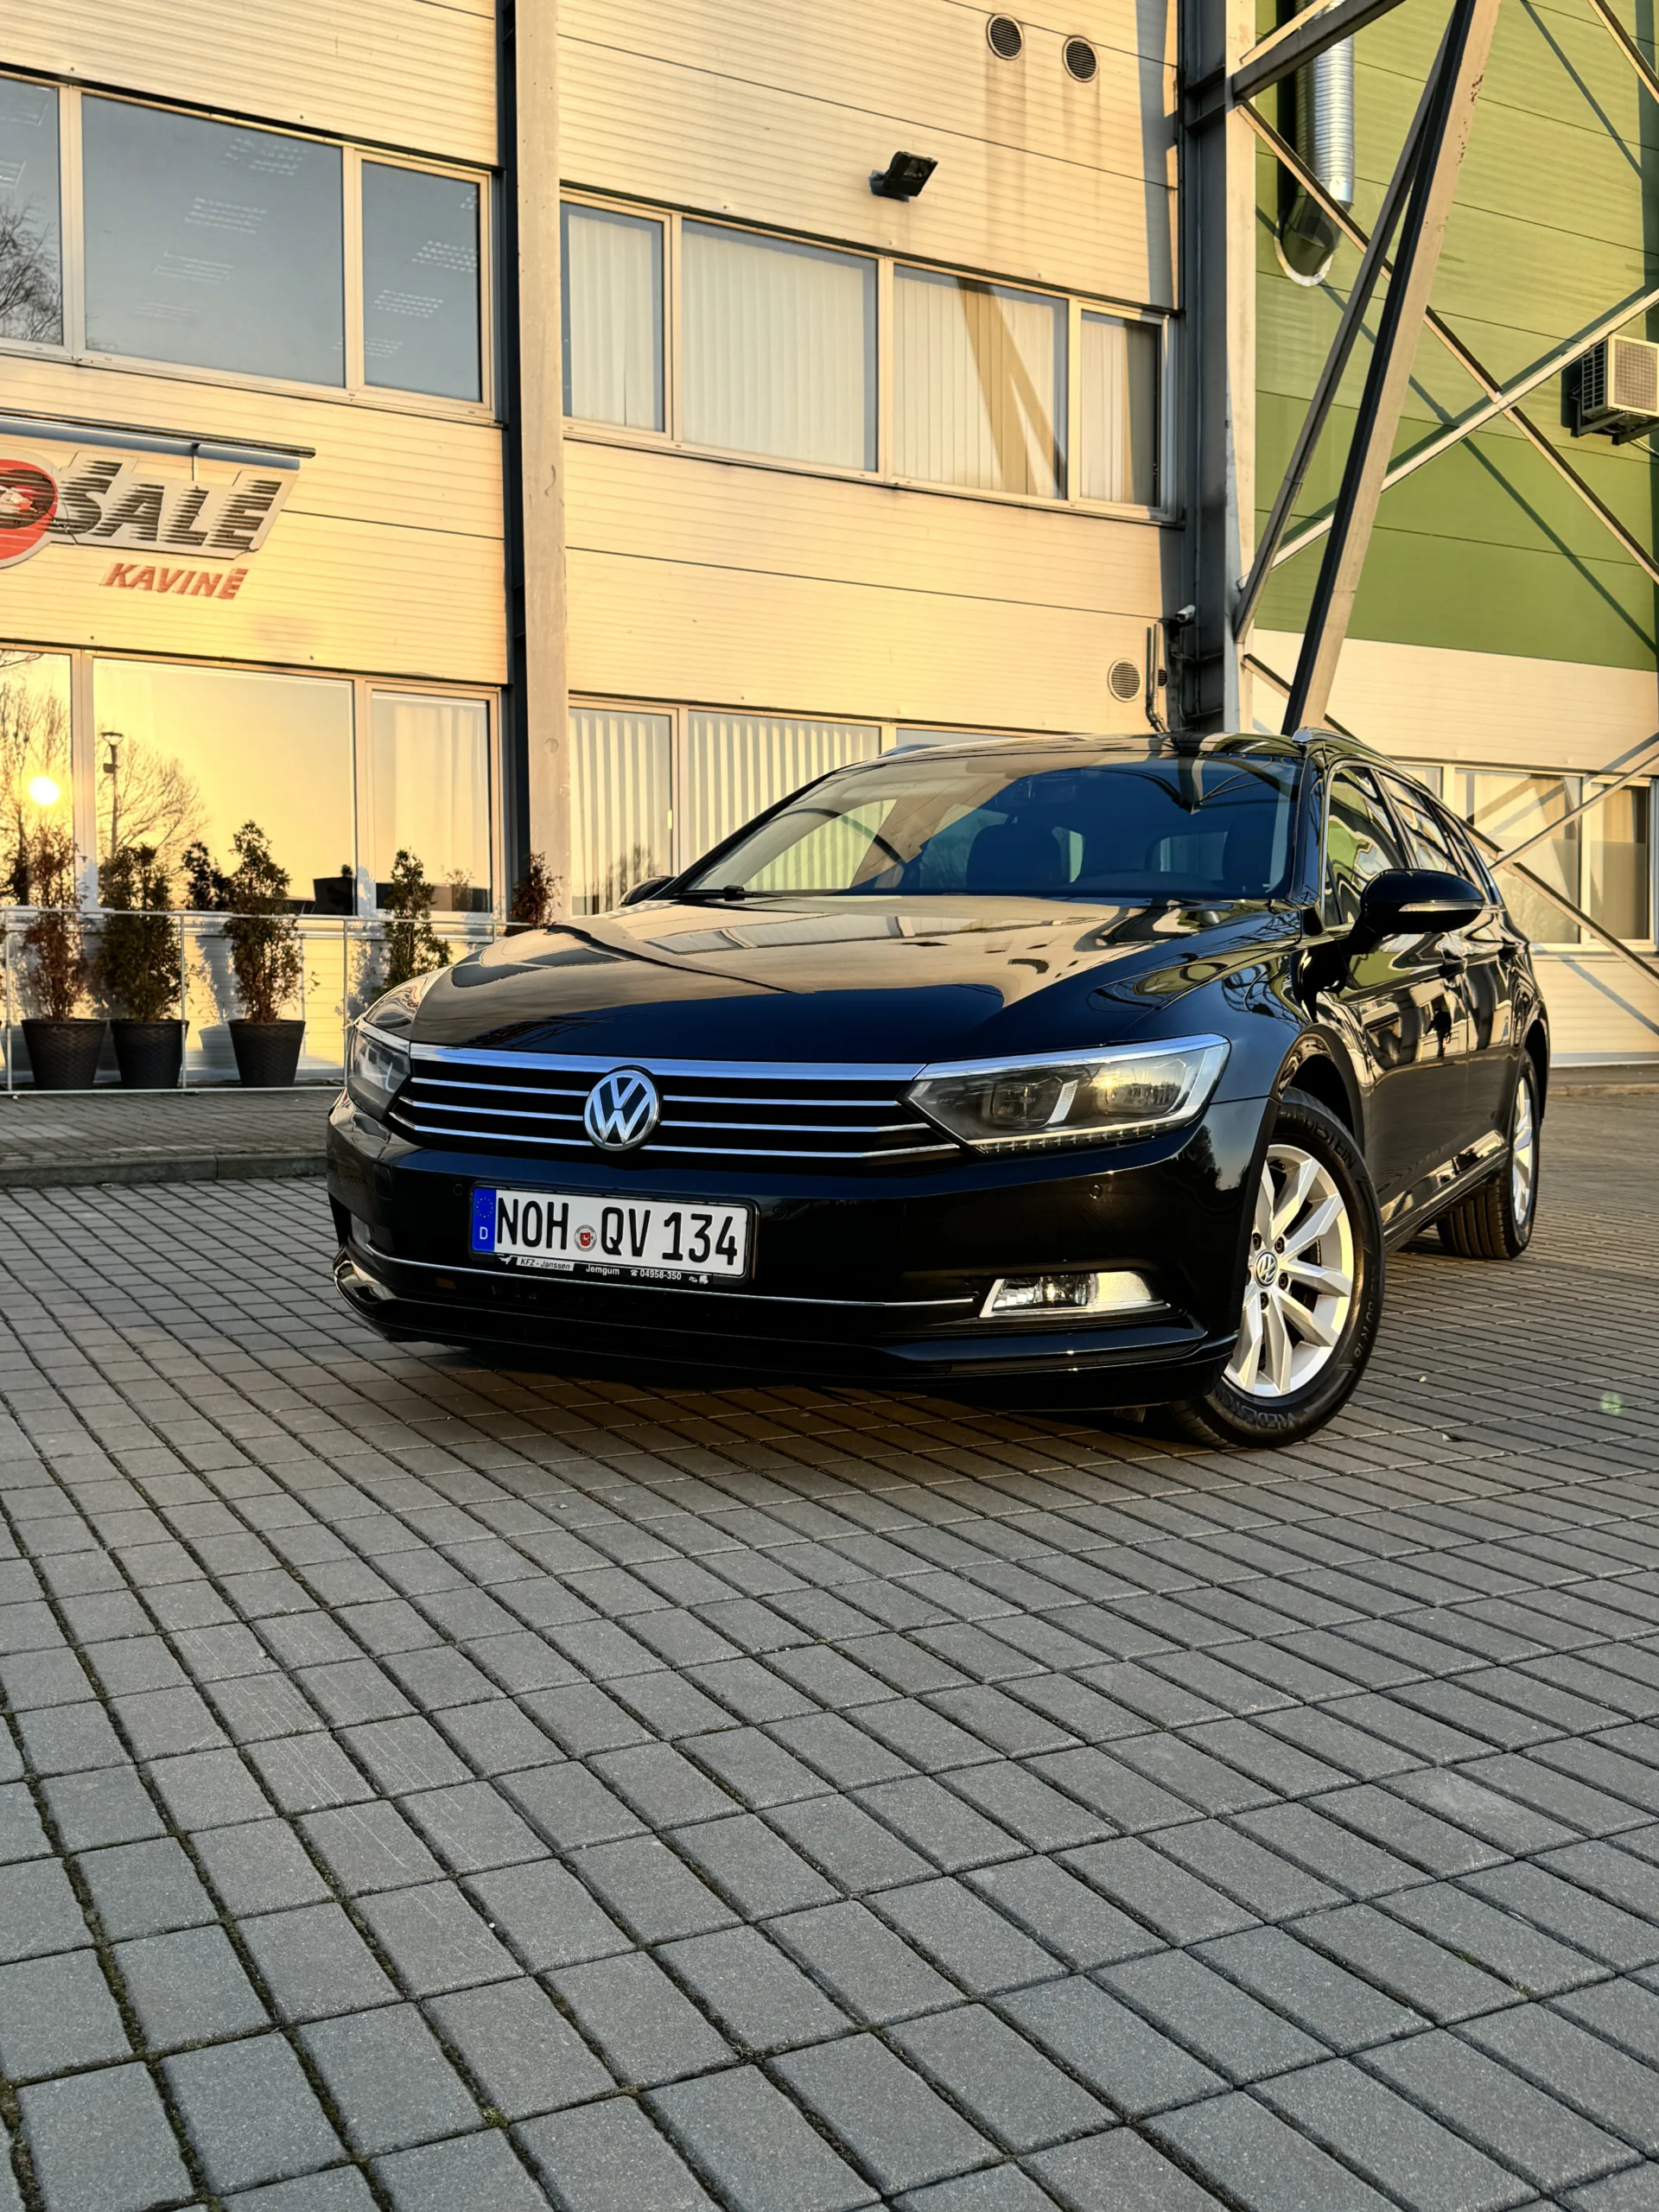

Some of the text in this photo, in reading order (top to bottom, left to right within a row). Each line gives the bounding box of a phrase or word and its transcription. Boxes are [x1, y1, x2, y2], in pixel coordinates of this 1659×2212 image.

[480, 1226, 488, 1240] D
[497, 1197, 569, 1249] NOH
[601, 1206, 652, 1255] QV
[662, 1211, 737, 1266] 134
[520, 1257, 536, 1267] KFZ
[541, 1261, 570, 1270] Janssen
[640, 1268, 681, 1281] 04958-350
